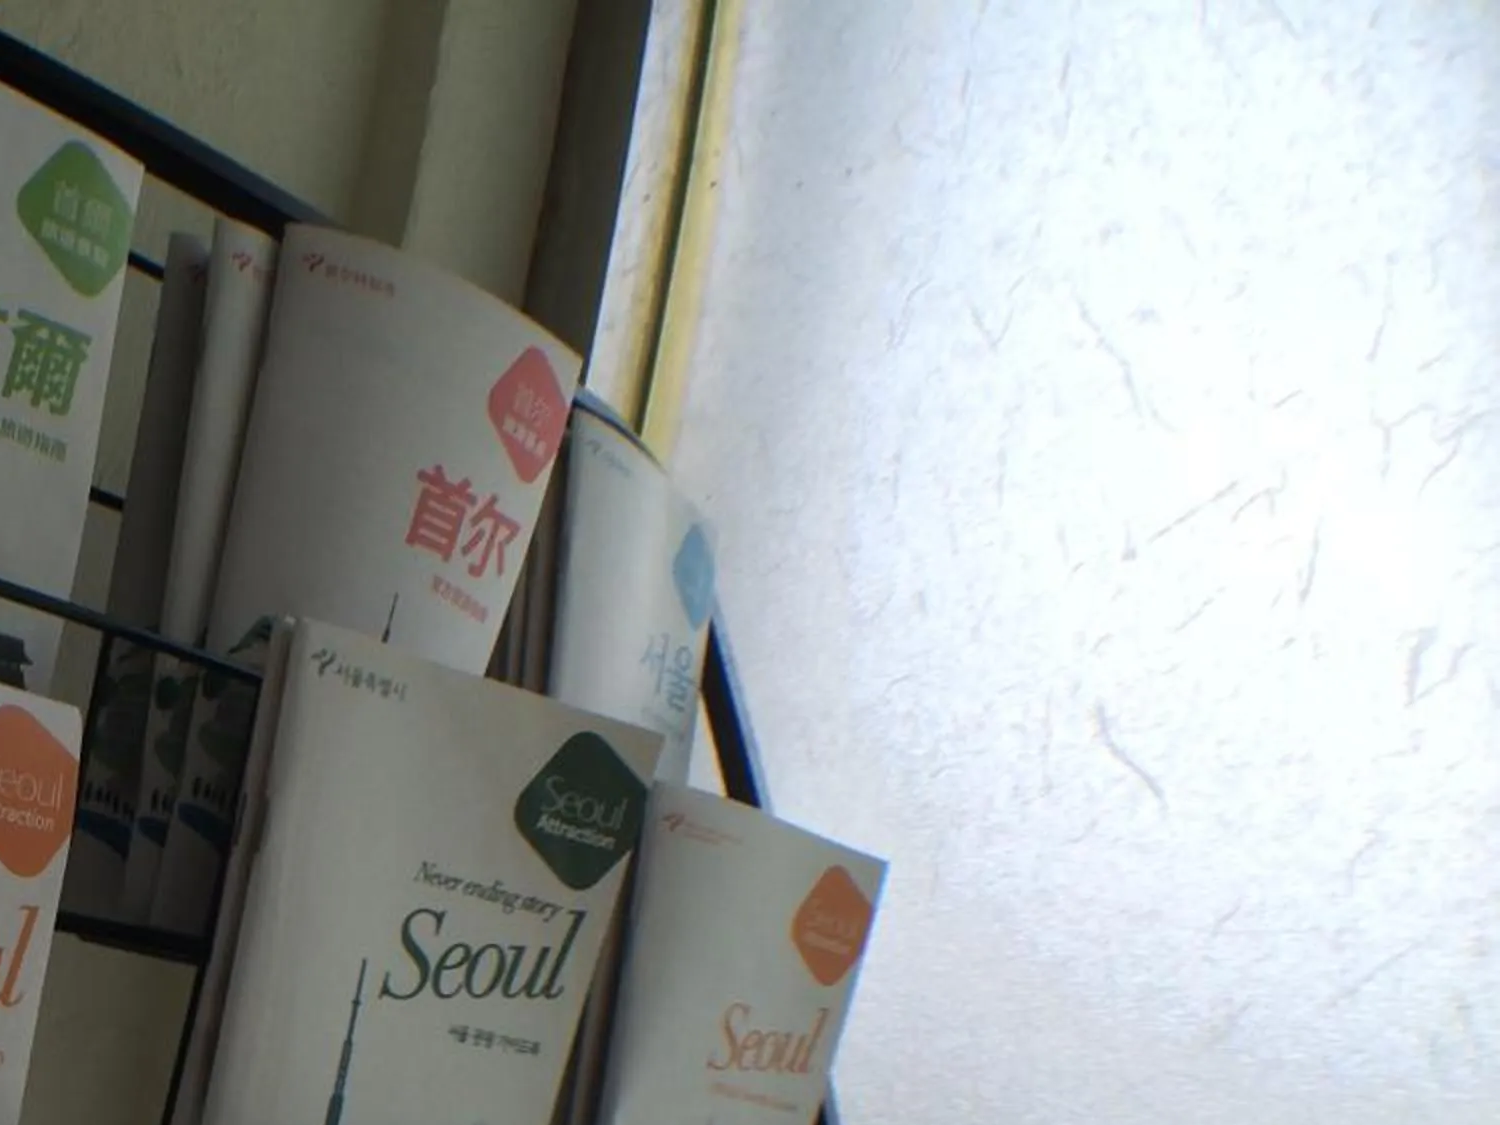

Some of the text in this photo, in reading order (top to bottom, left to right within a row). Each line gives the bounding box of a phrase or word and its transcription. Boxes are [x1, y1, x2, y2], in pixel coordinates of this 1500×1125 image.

[404, 463, 521, 579] 首尔
[536, 813, 616, 851] Attraction
[539, 773, 629, 832] Seoul
[413, 860, 565, 923] Never ending story
[378, 907, 587, 1002] Seoul
[706, 1002, 831, 1074] Seoul
